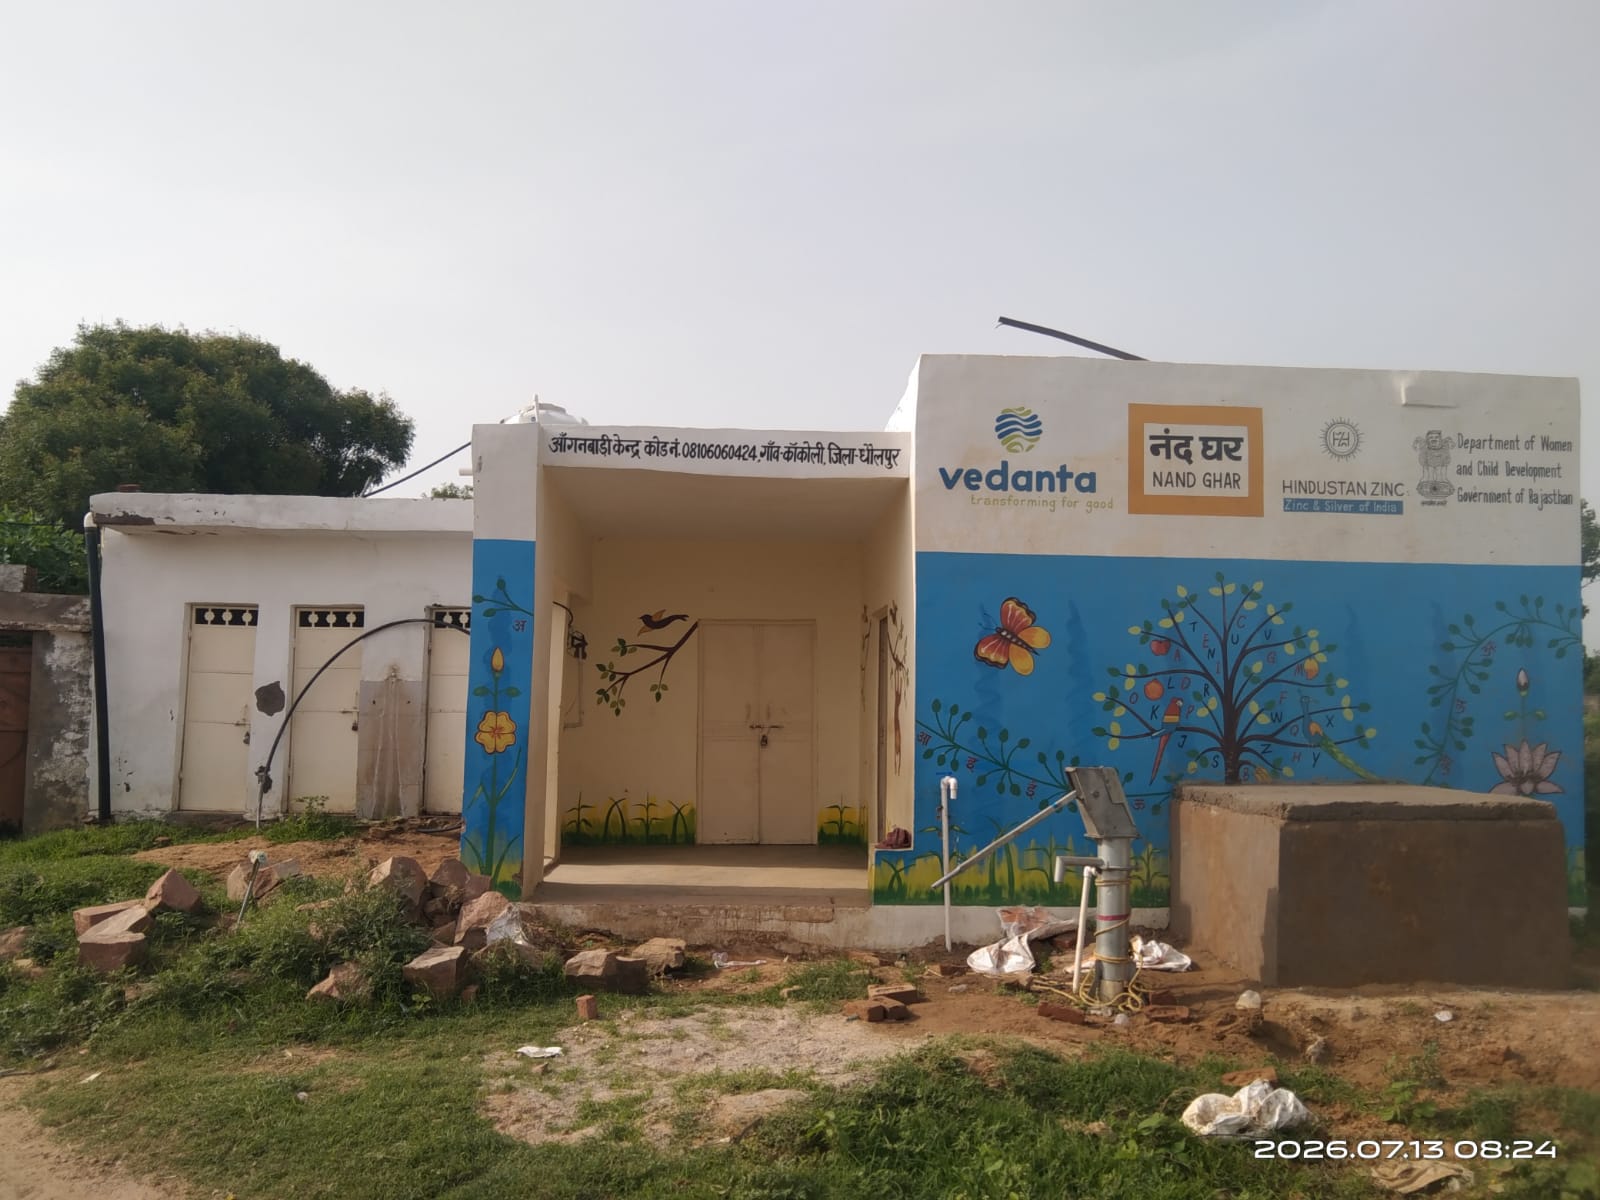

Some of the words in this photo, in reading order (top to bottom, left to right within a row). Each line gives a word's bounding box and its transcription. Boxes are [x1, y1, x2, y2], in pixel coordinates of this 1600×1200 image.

[644, 436, 669, 457] कोड
[1149, 428, 1194, 465] नंद
[1199, 436, 1244, 462] घर
[1457, 432, 1520, 453] Department
[1524, 433, 1535, 450] of
[1540, 433, 1572, 453] Women
[938, 460, 1097, 494] vedanta
[1456, 461, 1473, 477] and
[1477, 460, 1499, 477] Child
[1505, 461, 1562, 482] Development
[1152, 471, 1196, 489] NAND
[1202, 472, 1241, 490] GHAR
[1282, 480, 1369, 497] HINDUSTAN
[1370, 482, 1405, 498] ZINC
[970, 494, 1056, 512] transforming
[1061, 496, 1079, 510] for
[1085, 497, 1114, 514] good
[1457, 487, 1512, 505] Government
[1515, 487, 1526, 505] of
[1528, 488, 1574, 511] Rajasthan
[1284, 499, 1309, 512] Zinc
[1313, 501, 1321, 512] &
[1324, 501, 1354, 513] Silver
[1358, 501, 1370, 513] of
[1373, 501, 1397, 514] India
[512, 619, 527, 632] अ
[1189, 622, 1198, 633] T
[1202, 633, 1209, 648] E
[1231, 634, 1240, 645] U
[1264, 629, 1272, 641] V
[1207, 648, 1216, 660] N
[1167, 677, 1175, 690] L
[1204, 683, 1211, 696] R
[1150, 705, 1160, 720] K
[1270, 712, 1283, 723] W
[1326, 715, 1335, 728] X
[1178, 735, 1187, 748] J
[1260, 743, 1273, 754] Z
[1211, 754, 1220, 768] S
